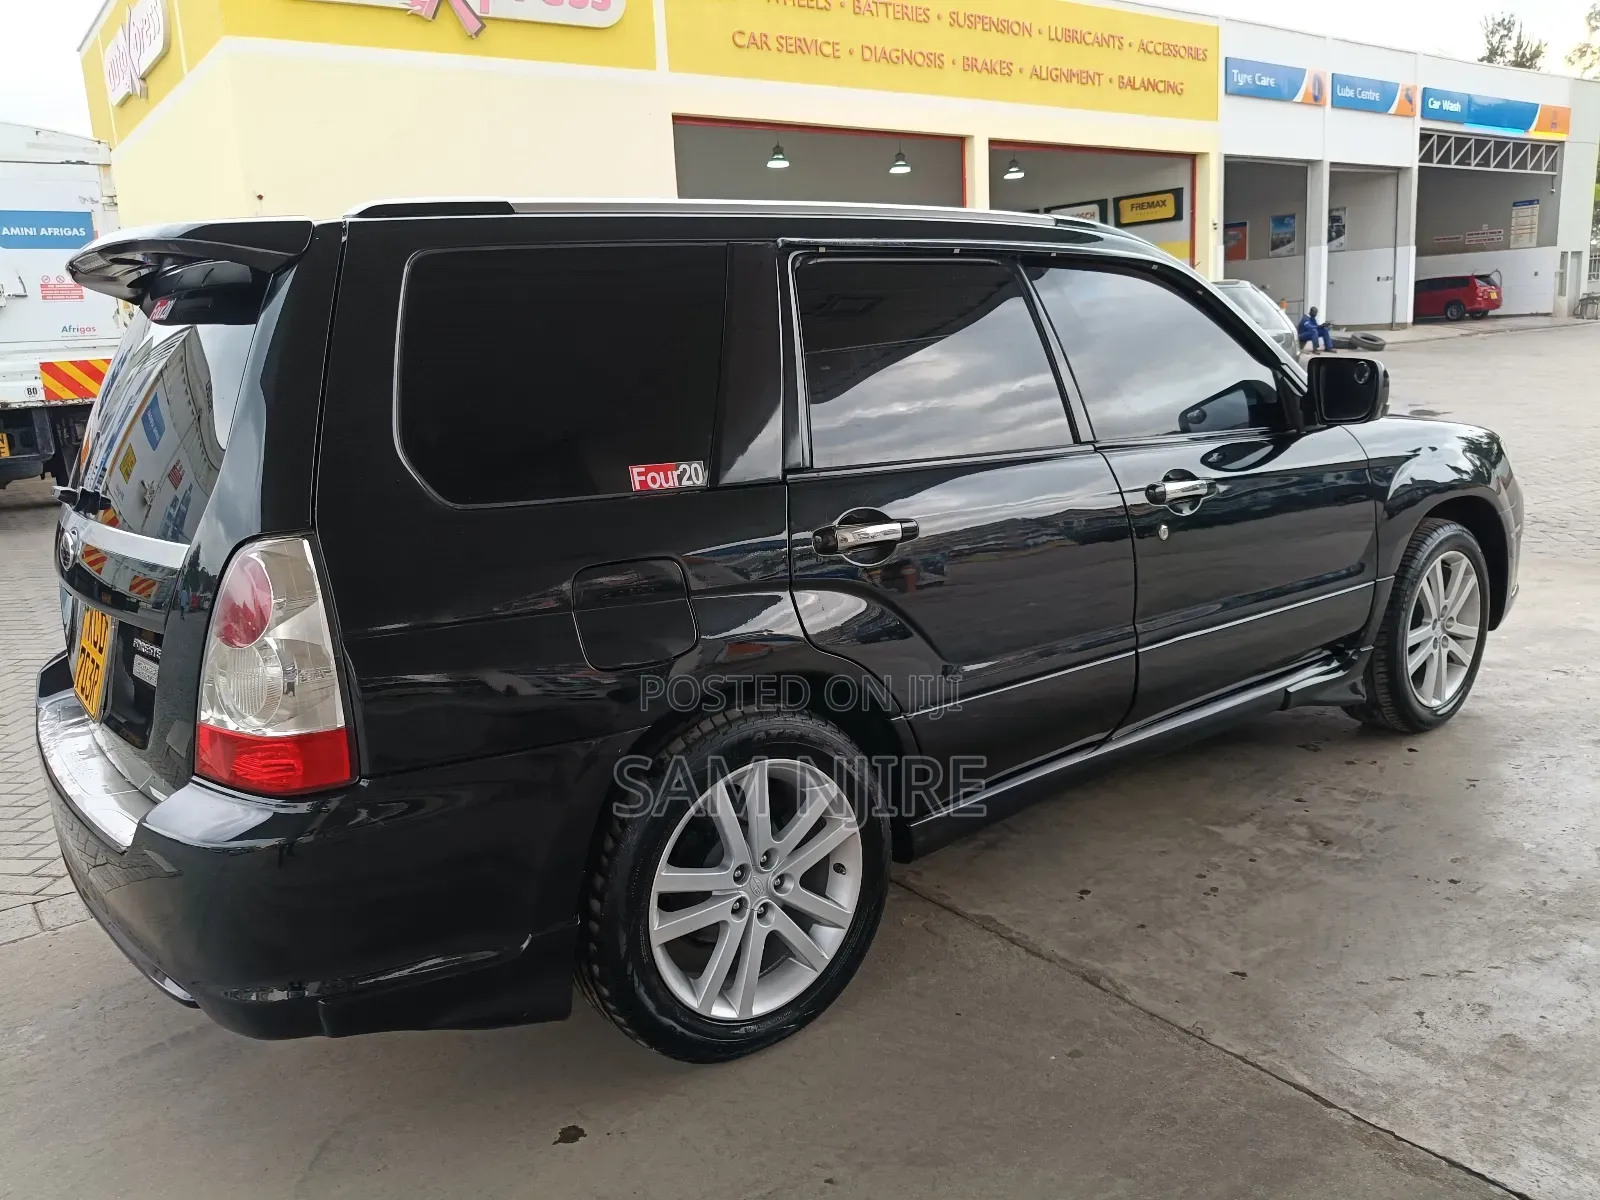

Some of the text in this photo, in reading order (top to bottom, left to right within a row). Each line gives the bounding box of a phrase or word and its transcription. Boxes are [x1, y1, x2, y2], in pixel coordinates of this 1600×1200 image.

[852, 0, 930, 23] BATTERIES
[949, 11, 1032, 37] SUSPENSION
[1048, 25, 1124, 50] LUBRICANTS
[1138, 39, 1208, 62] ACCESSORIES
[732, 30, 1184, 96] CAR SERVICE DIAGNOSIS BRAKES ALIGNMENT BALANCING
[1231, 69, 1276, 87] Tyre Care
[1336, 84, 1380, 101] Lube Centre
[1428, 98, 1461, 112] Car Wash
[1129, 199, 1167, 212] FREMAX
[1, 227, 86, 236] AMINI AFRIGAS
[61, 324, 97, 334] Afrigas
[27, 387, 37, 395] 80
[631, 462, 704, 489] Four20
